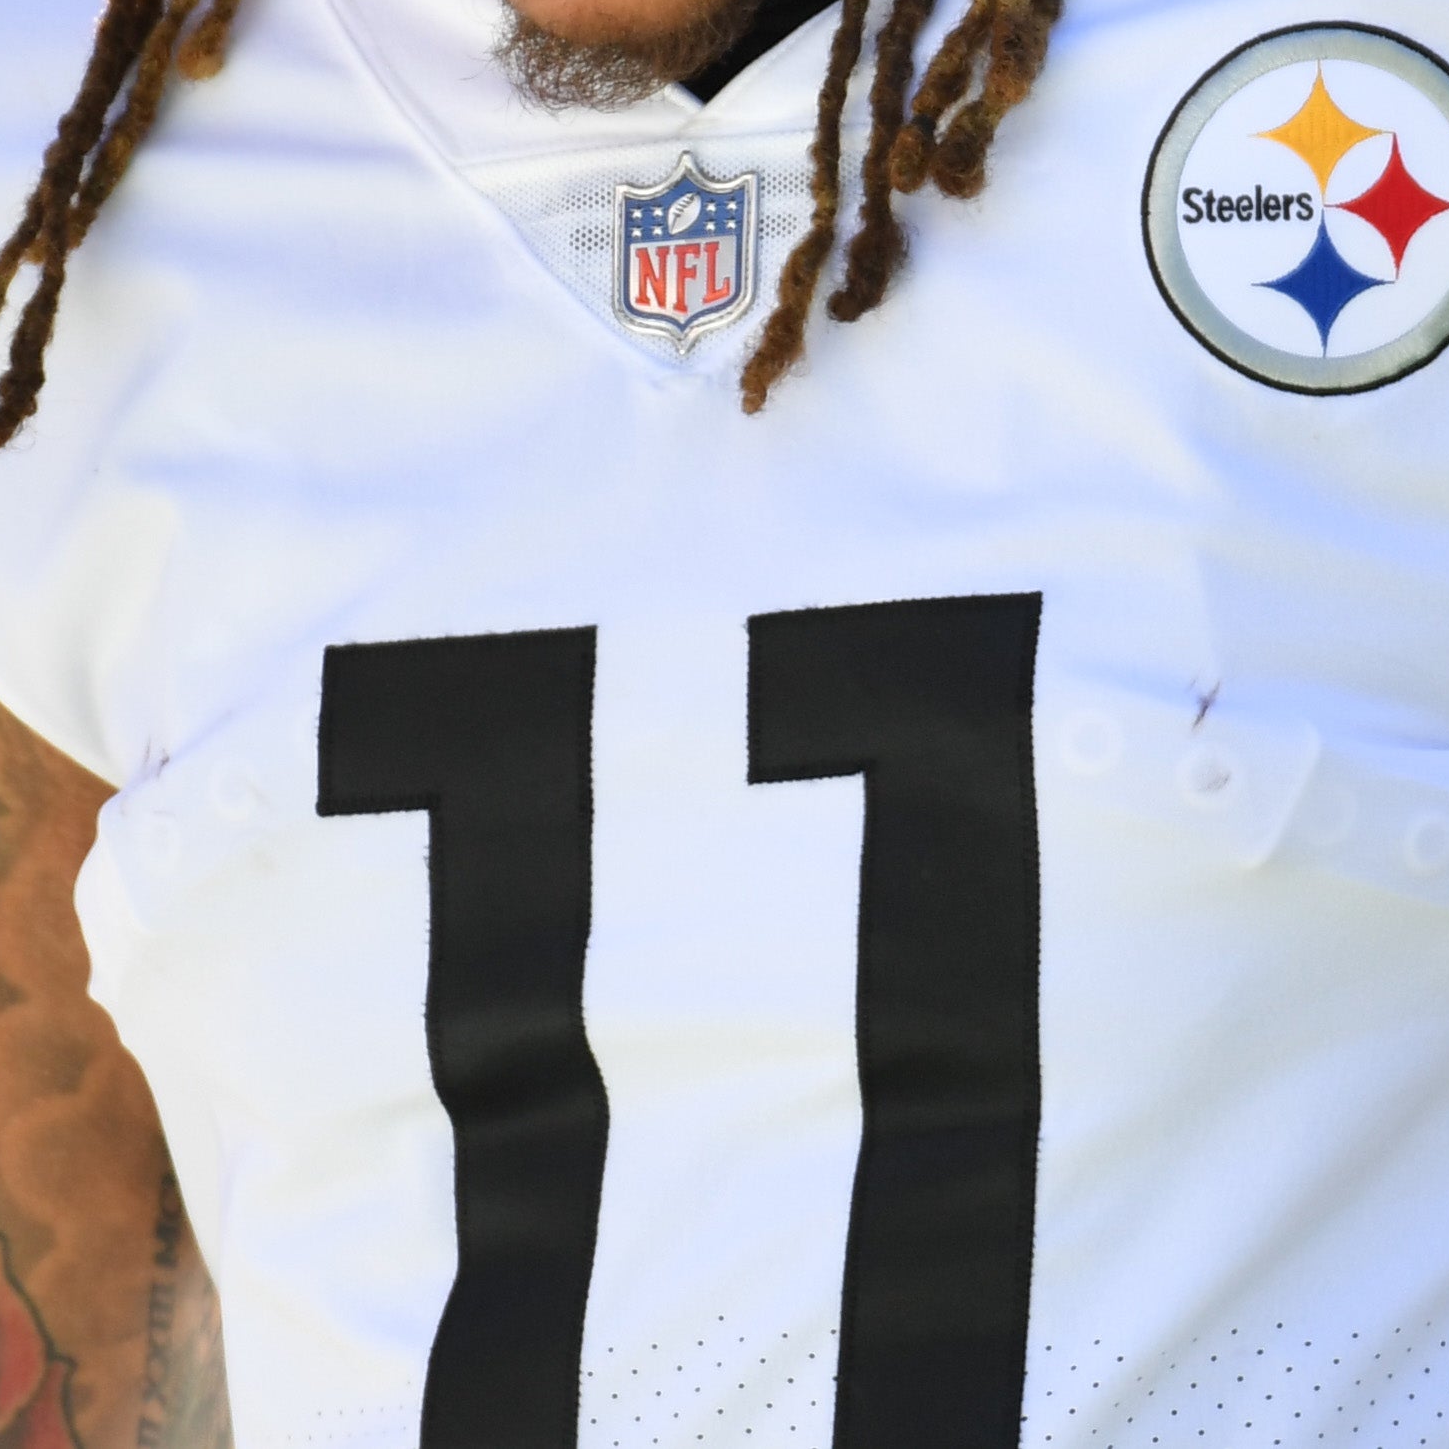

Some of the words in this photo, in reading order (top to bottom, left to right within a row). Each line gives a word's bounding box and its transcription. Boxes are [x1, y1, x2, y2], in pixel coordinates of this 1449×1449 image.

[1181, 184, 1314, 224] Steelers
[635, 241, 731, 314] NFL
[316, 591, 1043, 1449] 11
